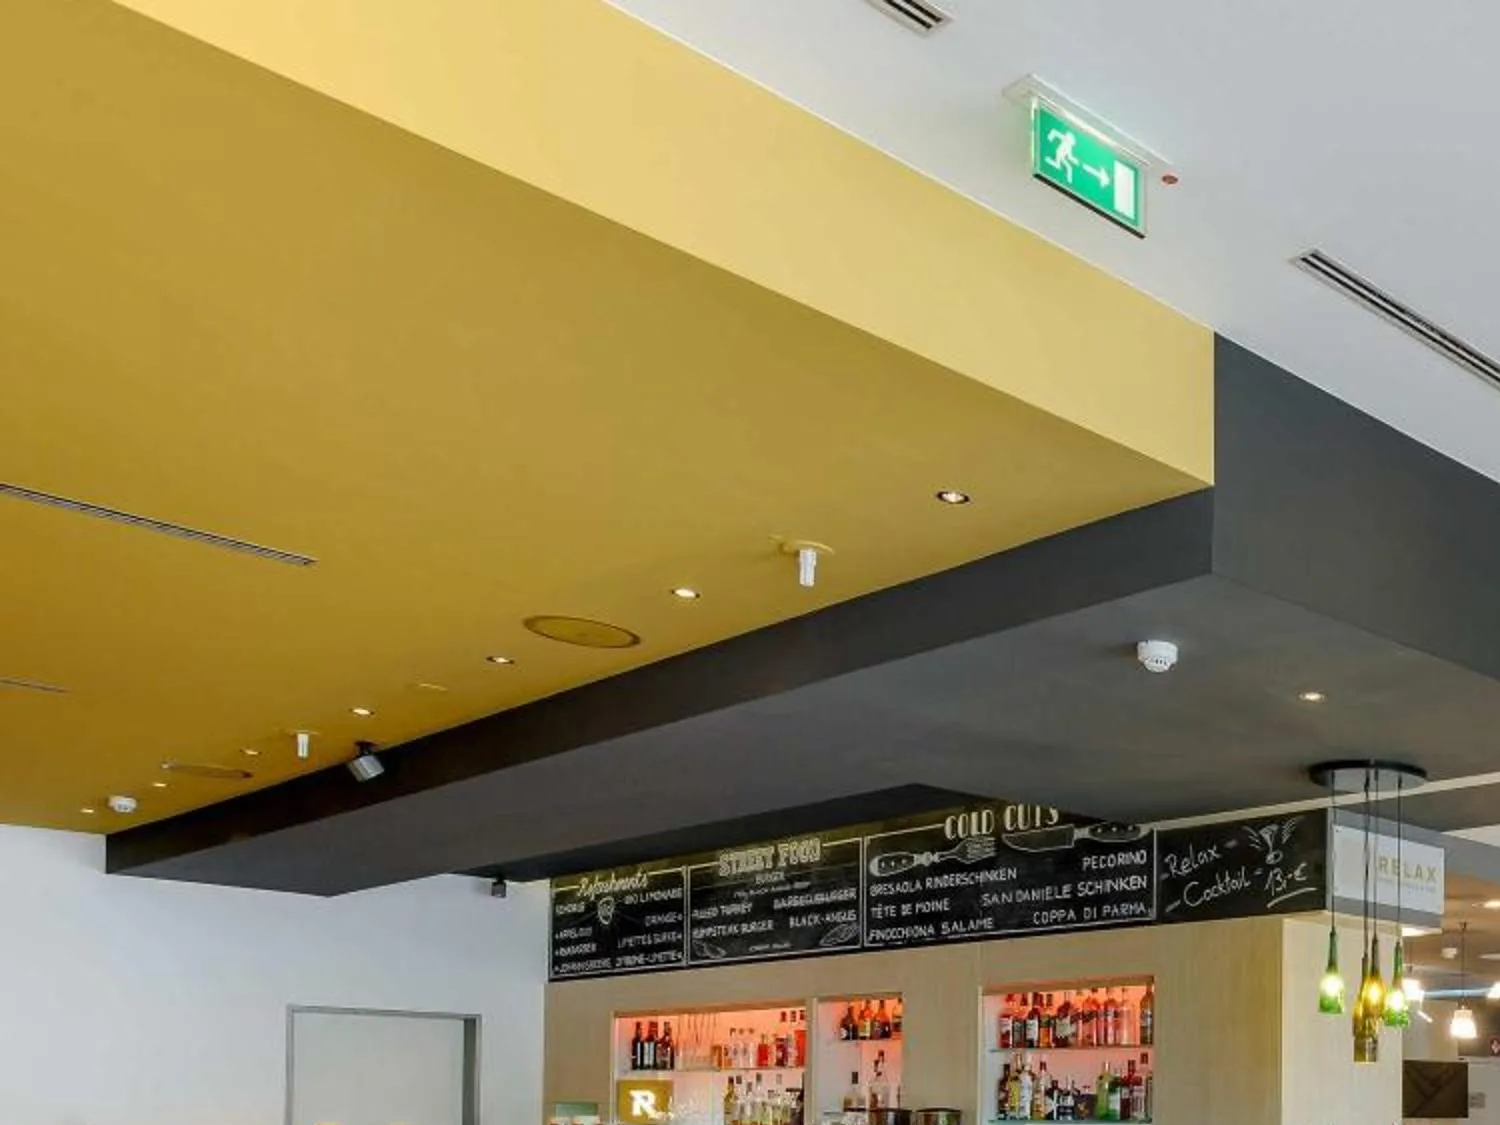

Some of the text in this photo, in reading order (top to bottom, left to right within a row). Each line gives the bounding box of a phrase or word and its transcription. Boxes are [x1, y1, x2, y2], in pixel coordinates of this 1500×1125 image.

[944, 810, 995, 840] COLD
[718, 838, 821, 877] STREET FOOD
[1082, 850, 1147, 871] PECORINO
[1164, 842, 1221, 878] Relax
[1378, 855, 1438, 884] RELAX
[869, 867, 1017, 897] BRESAOLA RINDERSCHINKEN
[981, 875, 1148, 907] SAN DANIELE SCHINKEN
[1184, 866, 1251, 907] Cocktail
[870, 903, 897, 919] TÊTE
[915, 897, 950, 914] MOINE
[1033, 901, 1146, 926] COPPA DI PARMA
[941, 916, 994, 935] SALAME
